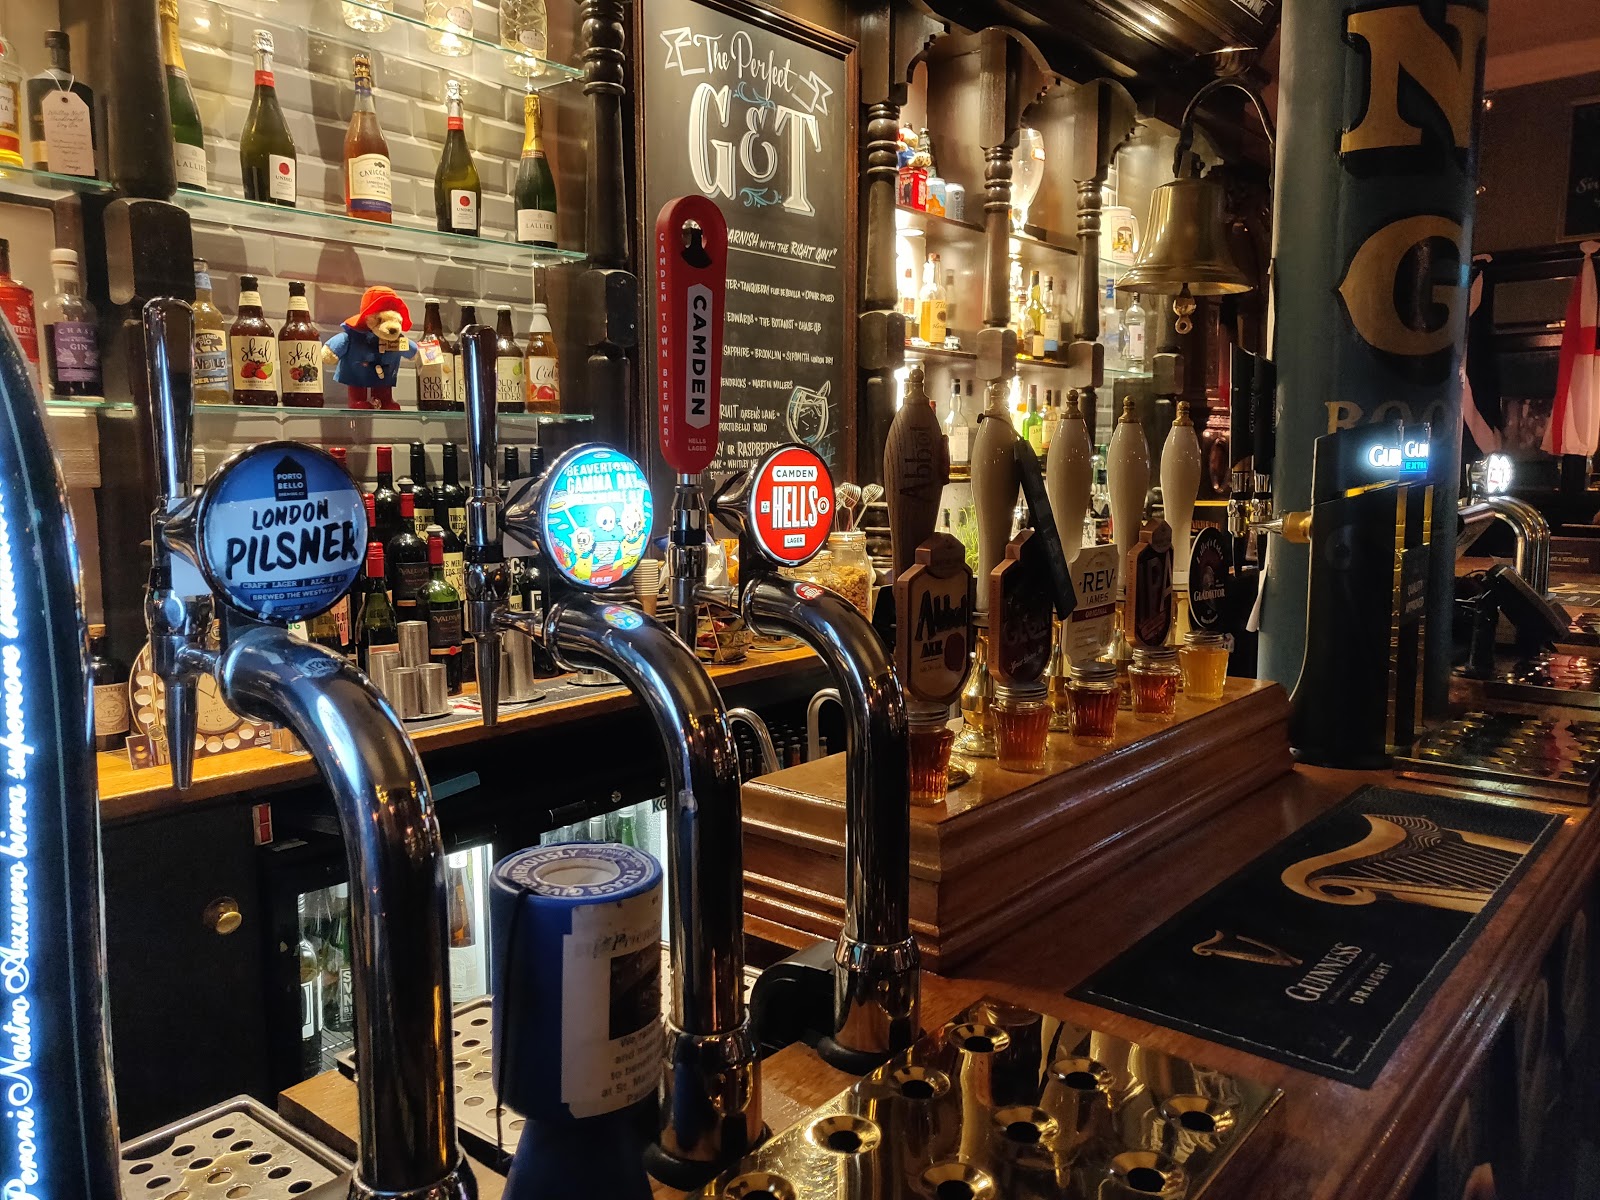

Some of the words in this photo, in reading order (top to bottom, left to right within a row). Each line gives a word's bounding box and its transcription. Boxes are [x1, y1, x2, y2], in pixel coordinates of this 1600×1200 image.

[693, 33, 730, 74] The
[731, 31, 798, 101] Perfect
[727, 229, 760, 248] ARNISH
[760, 240, 777, 252] WITH
[777, 243, 789, 254] THE
[790, 241, 815, 260] RIGHT
[655, 232, 666, 302] CAMDEN
[662, 368, 670, 448] BREWERY
[759, 317, 771, 327] THE
[70, 343, 88, 351] GIN
[691, 294, 707, 416] CAMDEN
[423, 377, 442, 385] OLD
[423, 392, 451, 400] CIDER
[727, 447, 735, 455] OR
[775, 469, 815, 478] CAMDEN
[252, 499, 329, 531] LONDON
[771, 485, 820, 529] HELLS
[225, 521, 359, 581] PILSNER
[786, 536, 804, 544] LAGER
[252, 592, 285, 601] BREWED
[287, 591, 301, 599] THE
[1082, 568, 1116, 593] REV
[0, 644, 36, 781] superiore
[0, 784, 29, 859] birra
[0, 859, 31, 995] Azzurro
[1285, 942, 1363, 1002] GUINNESS
[1350, 961, 1393, 1005] DRAUGHT
[0, 994, 34, 1107] Nastro
[0, 1105, 40, 1200] Peroni
